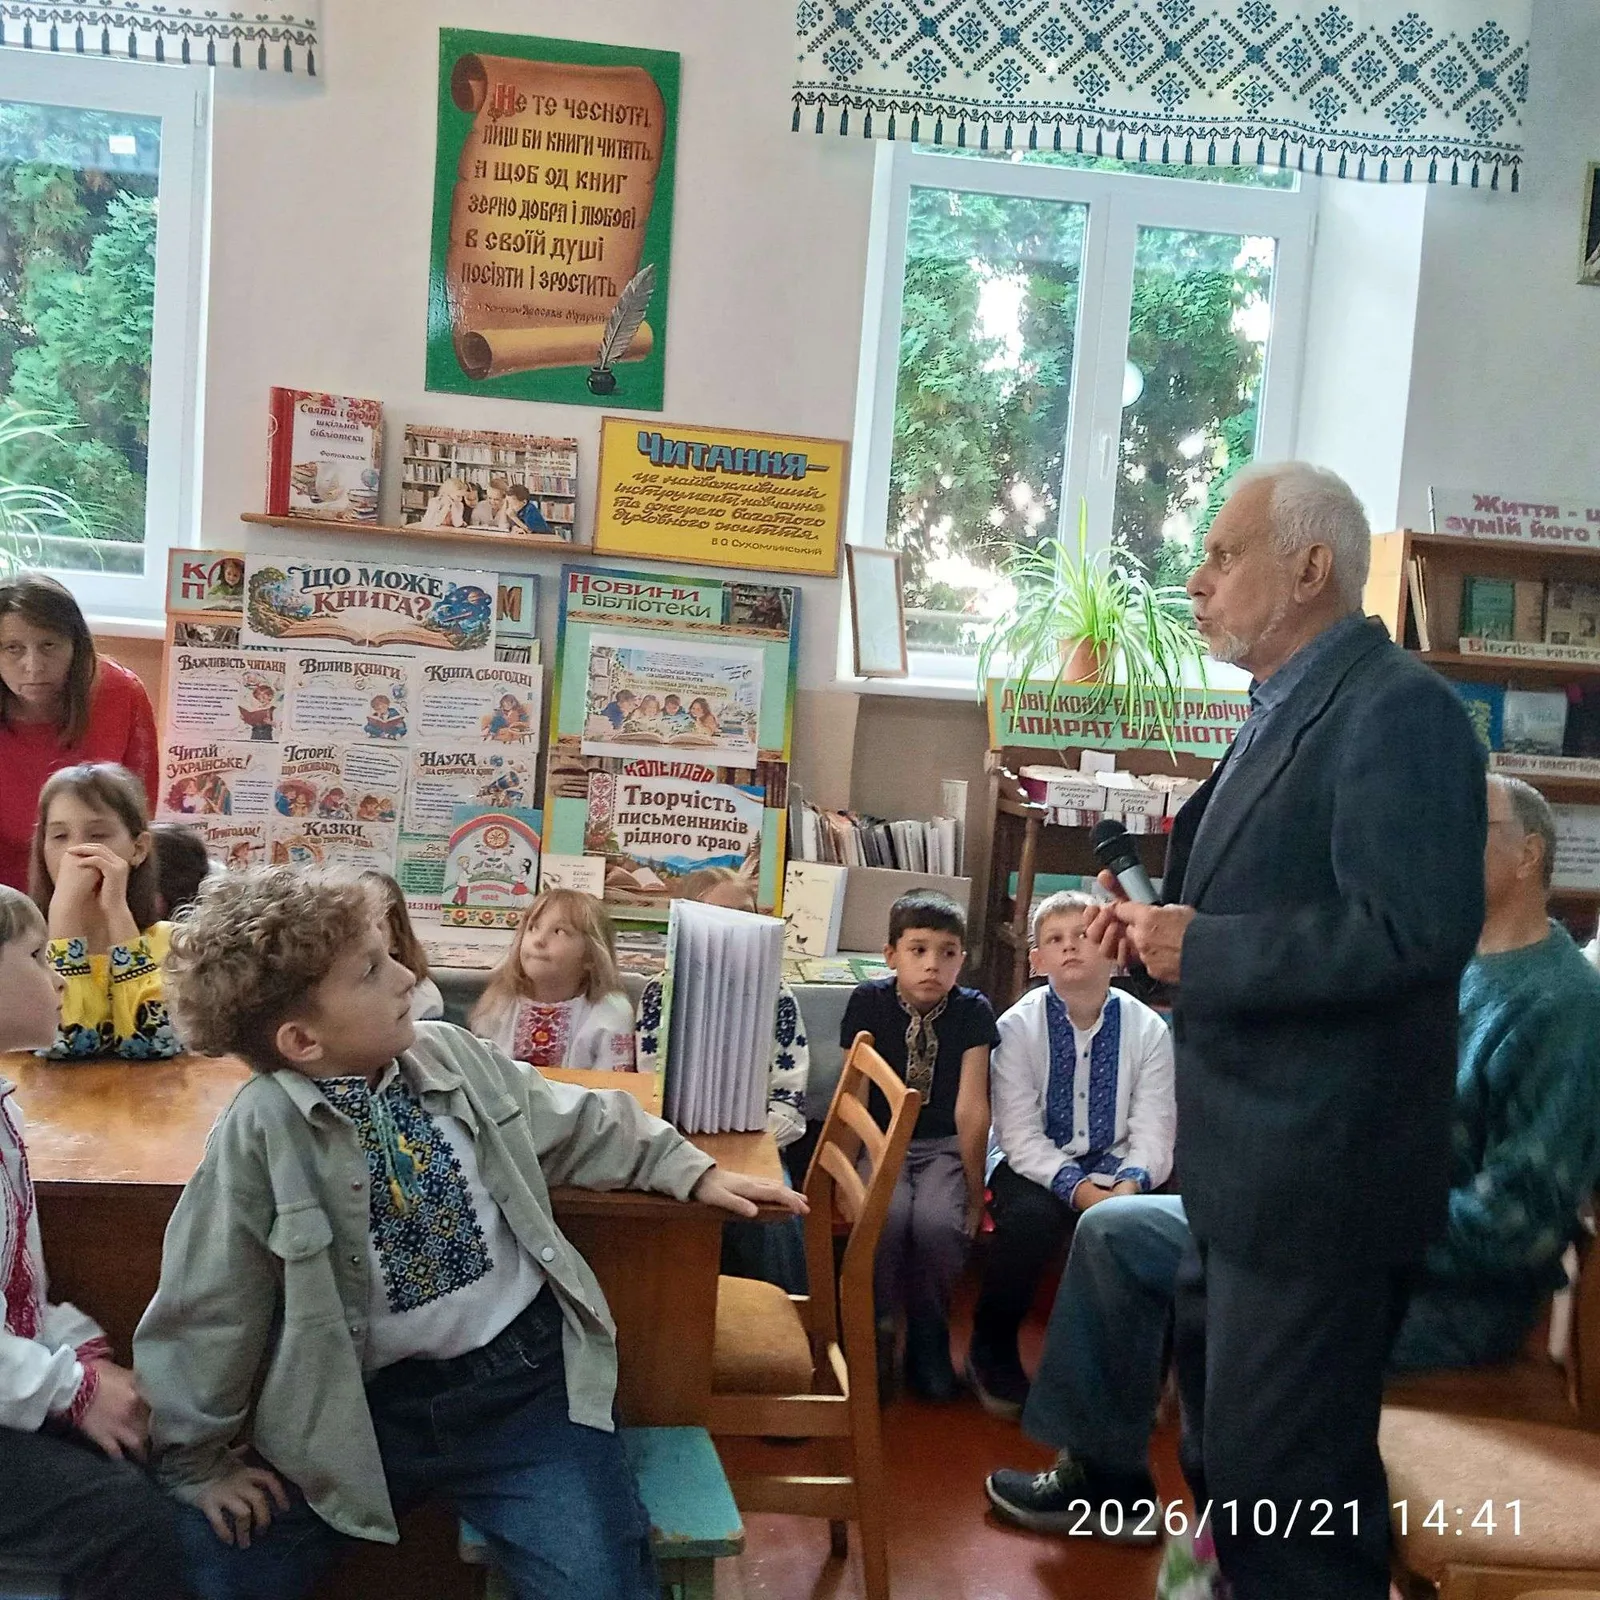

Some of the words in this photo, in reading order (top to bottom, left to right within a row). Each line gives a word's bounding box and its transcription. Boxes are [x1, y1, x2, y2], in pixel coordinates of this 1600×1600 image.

[310, 428, 364, 443] бібліотеки
[632, 471, 660, 484] це
[662, 475, 828, 499] найважливіший
[614, 482, 743, 507] інструмент
[742, 495, 826, 513] навчання
[1473, 493, 1559, 519] Життя
[612, 508, 709, 530] духовного
[613, 496, 640, 509] та
[642, 500, 726, 518] джерело
[731, 507, 826, 528] багатого
[1529, 521, 1590, 542] його
[289, 564, 350, 593] ЩО
[356, 567, 444, 599] МОЖЕ
[311, 591, 432, 622] КНИГА?
[299, 658, 352, 674] ВПЛИВ
[353, 662, 401, 680] КНИГИ
[424, 664, 474, 682] КНИГА
[476, 668, 532, 687] СЬОГОДНІ
[1009, 716, 1114, 738] АПАРАТ
[168, 744, 218, 761] ЧИТАЙ
[420, 751, 477, 766] НАУКА
[166, 755, 252, 778] УКРАЇНСЬКЕ!
[624, 784, 736, 813] Творчість
[618, 812, 748, 834] письменників
[624, 827, 691, 847] рідного
[697, 835, 741, 852] краю
